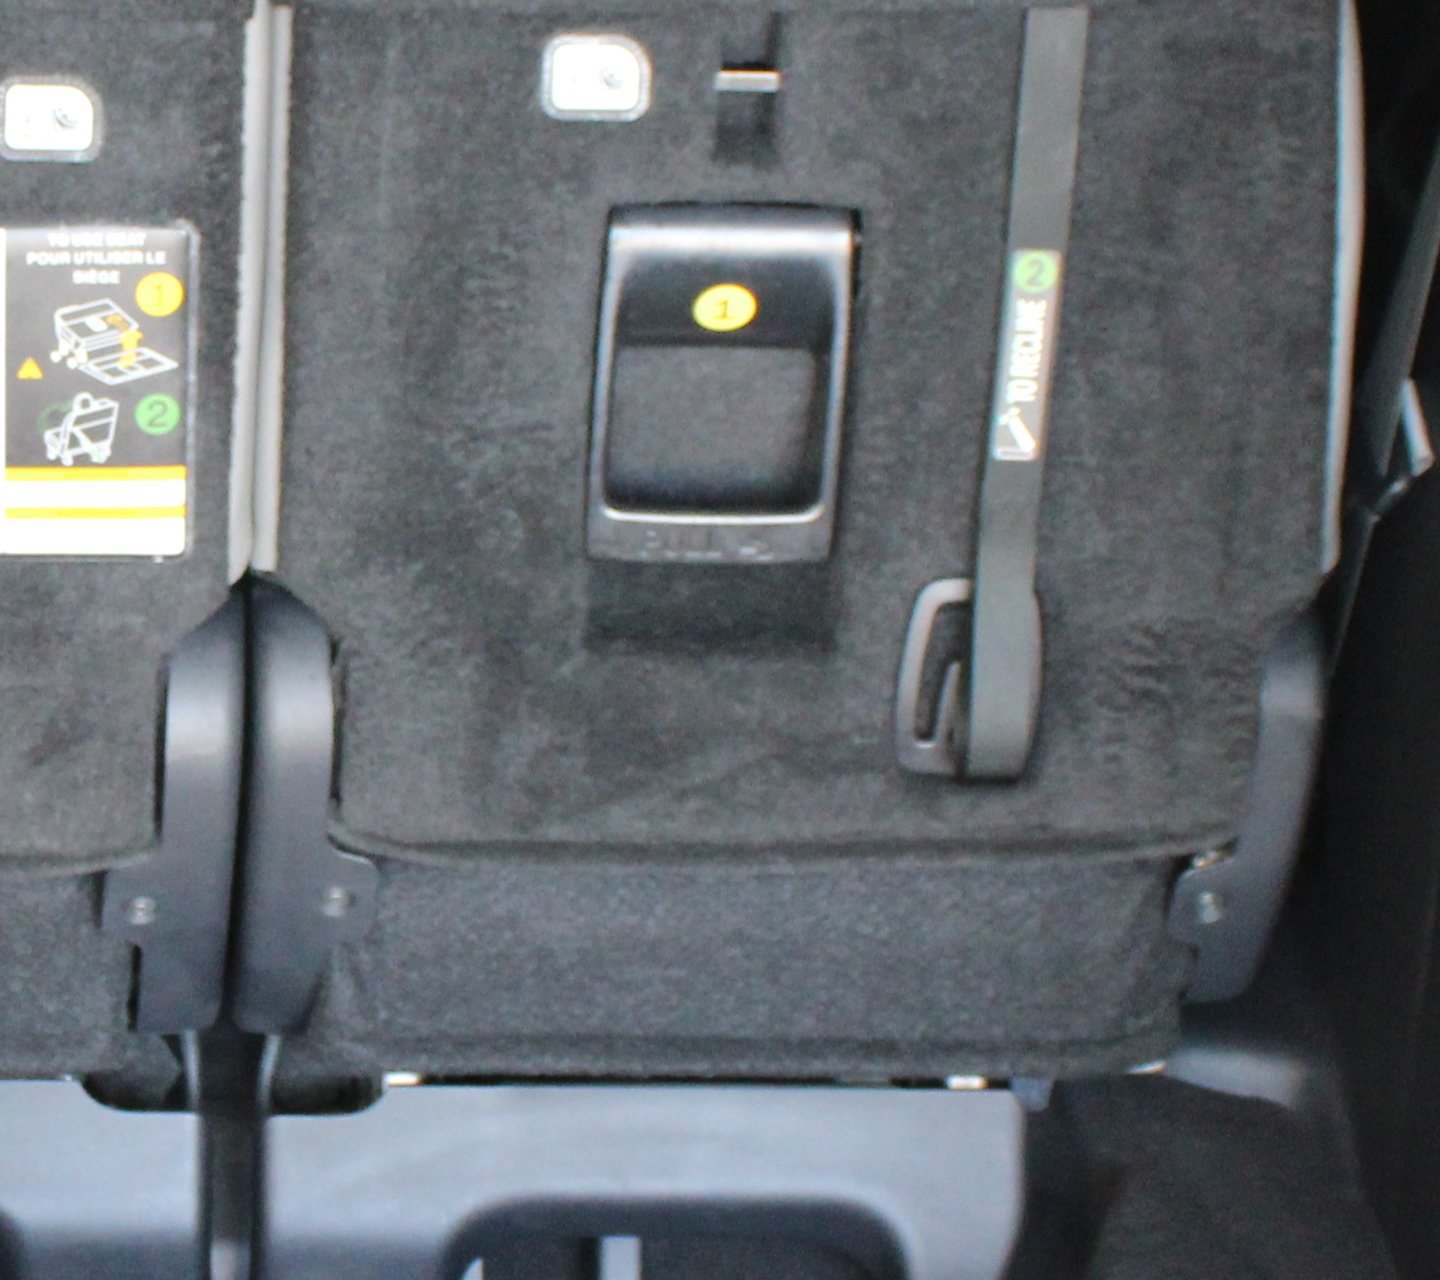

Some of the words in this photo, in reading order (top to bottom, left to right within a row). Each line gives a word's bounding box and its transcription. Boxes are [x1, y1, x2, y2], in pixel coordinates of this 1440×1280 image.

[26, 251, 70, 266] POUR
[146, 251, 166, 265] LE
[1025, 258, 1045, 287] 2
[712, 299, 735, 320] 1
[147, 399, 169, 427] 2
